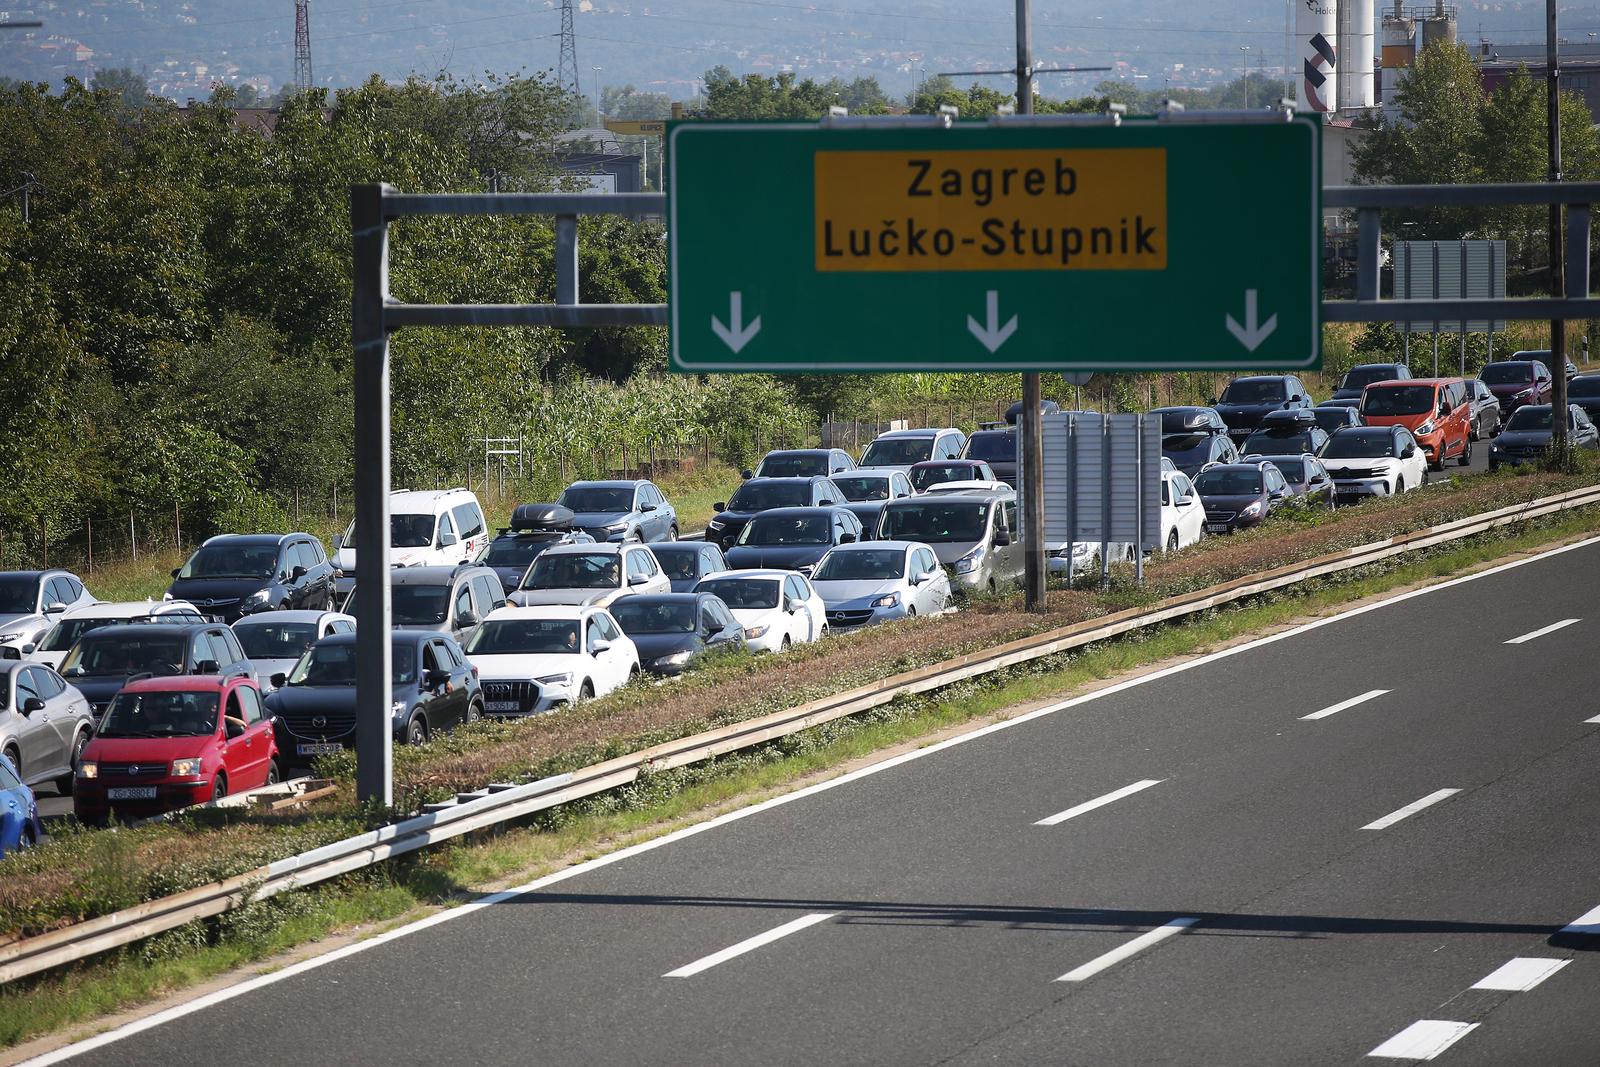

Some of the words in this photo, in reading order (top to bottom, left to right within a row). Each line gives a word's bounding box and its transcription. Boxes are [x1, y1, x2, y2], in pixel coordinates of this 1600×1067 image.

[1315, 7, 1336, 15] Holci
[908, 158, 1076, 206] Zagreb
[825, 216, 1156, 264] Lučko-Stupnik
